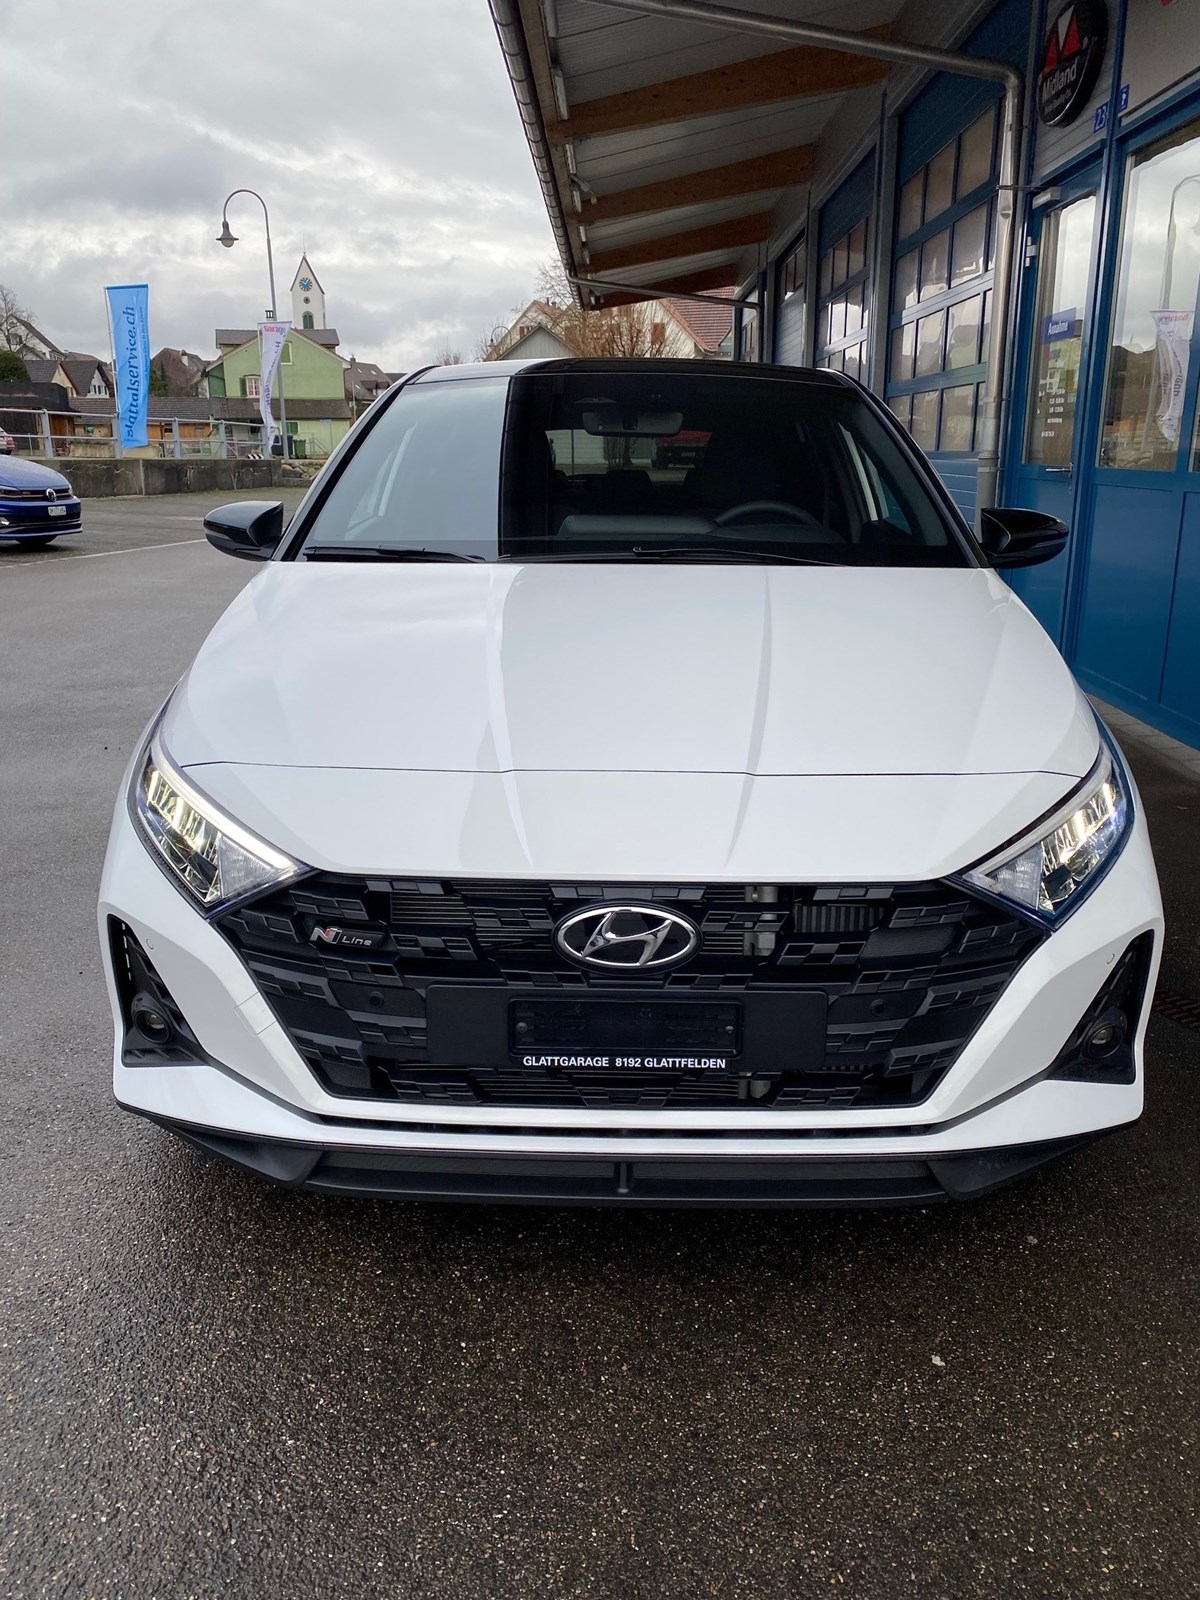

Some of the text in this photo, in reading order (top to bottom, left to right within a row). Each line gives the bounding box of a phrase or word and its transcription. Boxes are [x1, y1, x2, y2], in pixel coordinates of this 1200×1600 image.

[1042, 56, 1078, 102] Midland
[342, 936, 372, 946] Line
[523, 1056, 726, 1069] GLATTGARAGE 8192 GLATTFELDEN
